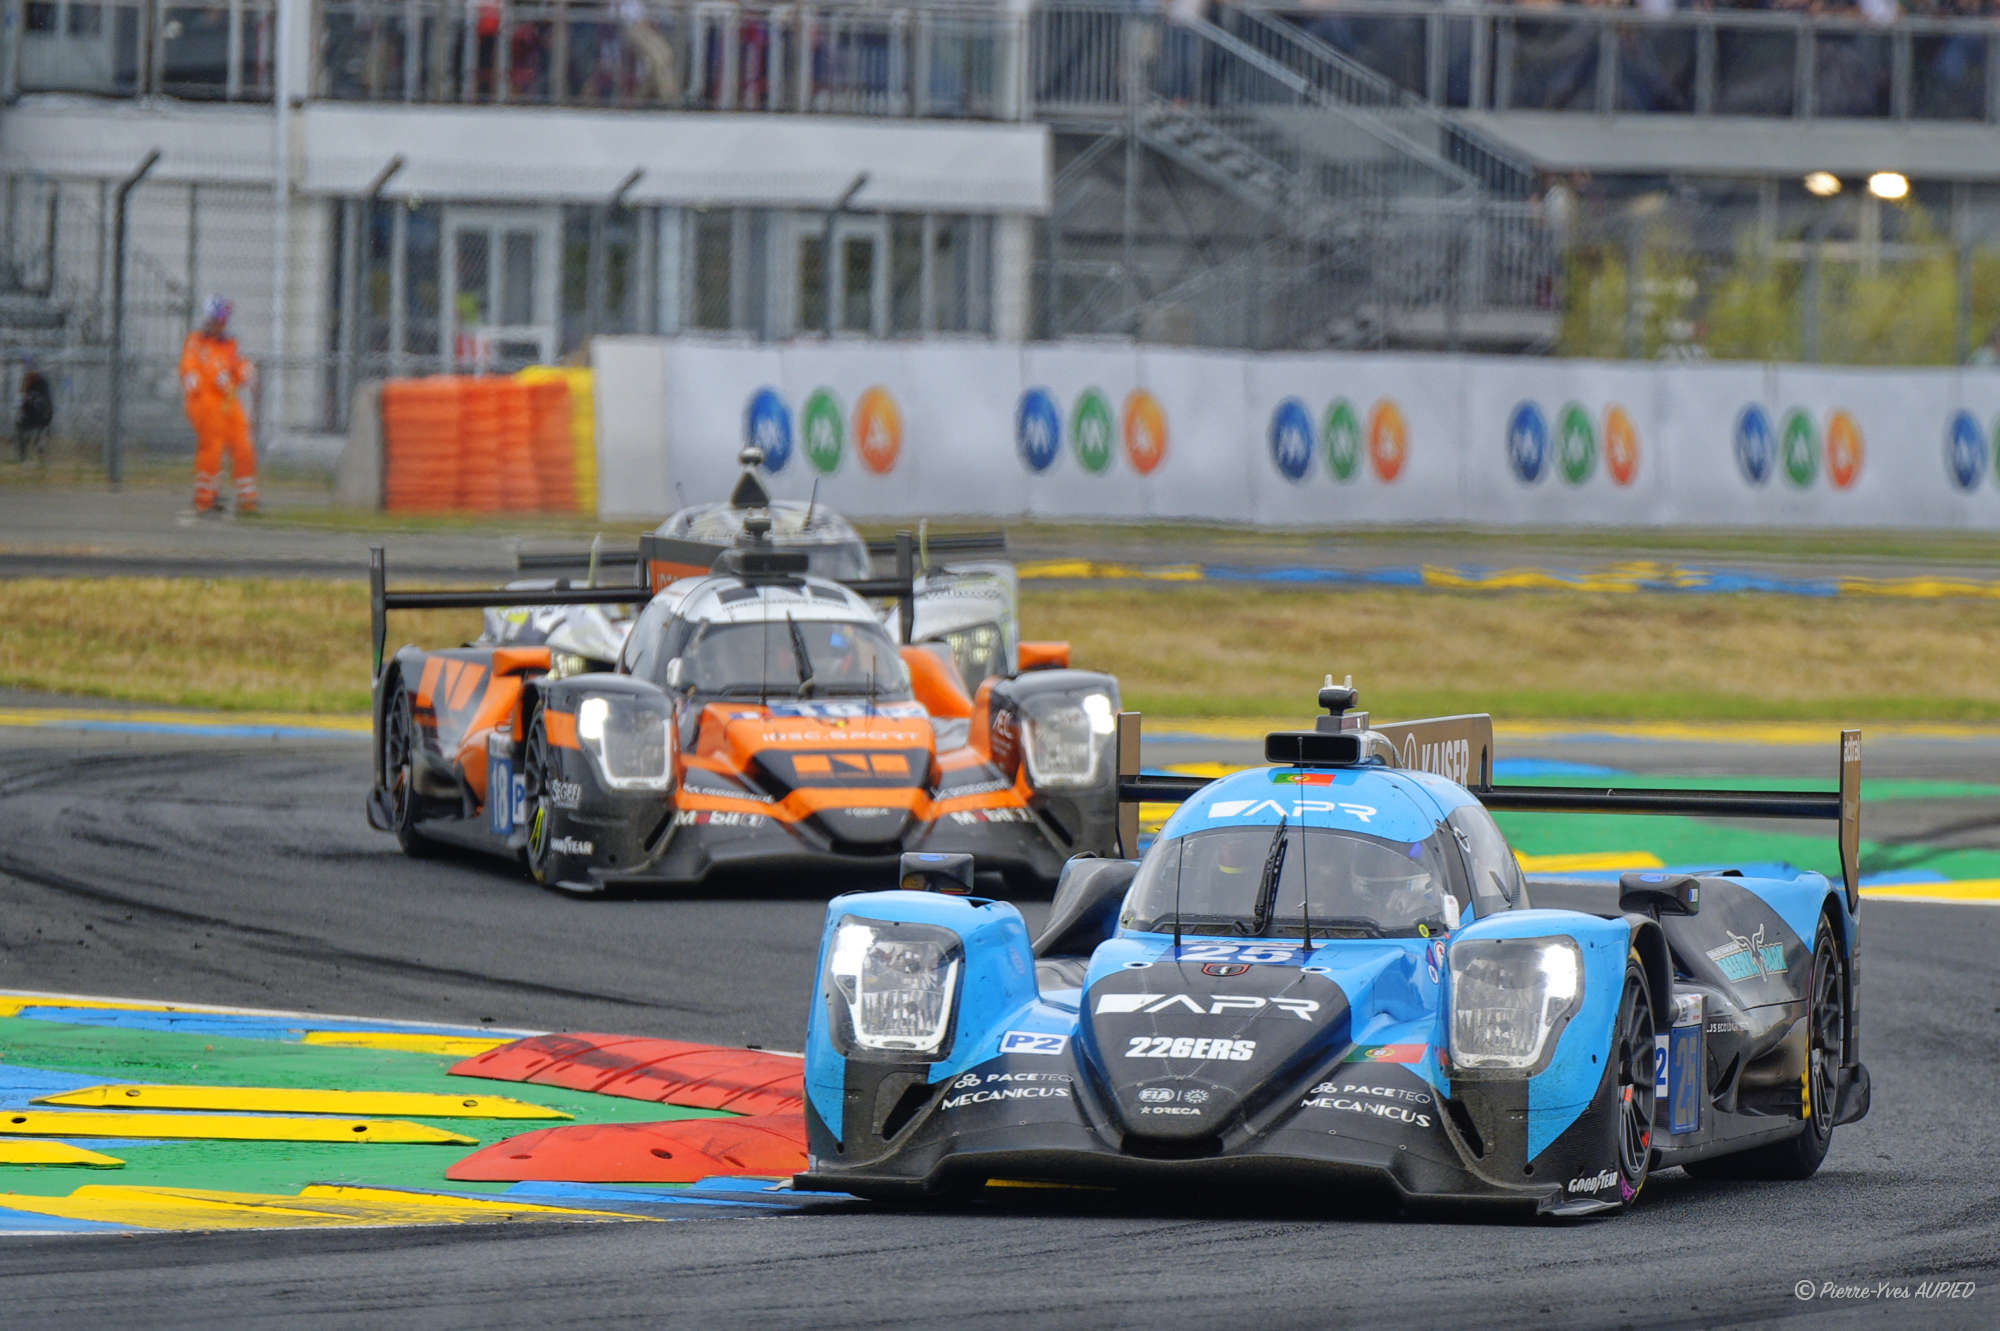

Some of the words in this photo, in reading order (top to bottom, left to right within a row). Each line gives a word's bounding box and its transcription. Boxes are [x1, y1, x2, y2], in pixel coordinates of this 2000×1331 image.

[1421, 738, 1470, 791] KAISER
[1243, 799, 1377, 823] APR
[1177, 945, 1297, 962] 25
[1144, 994, 1320, 1022] APR
[1005, 1034, 1062, 1051] P2
[1124, 1036, 1257, 1061] 226ERS
[1674, 1036, 1698, 1124] 25
[941, 1087, 1071, 1111] MECANICUS
[1141, 1089, 1172, 1100] FIA
[1343, 1084, 1431, 1104] PACETEQ
[1153, 1106, 1201, 1115] ORECA
[1300, 1097, 1431, 1128] MECANICUS
[1568, 1169, 1618, 1195] GOODYEAR
